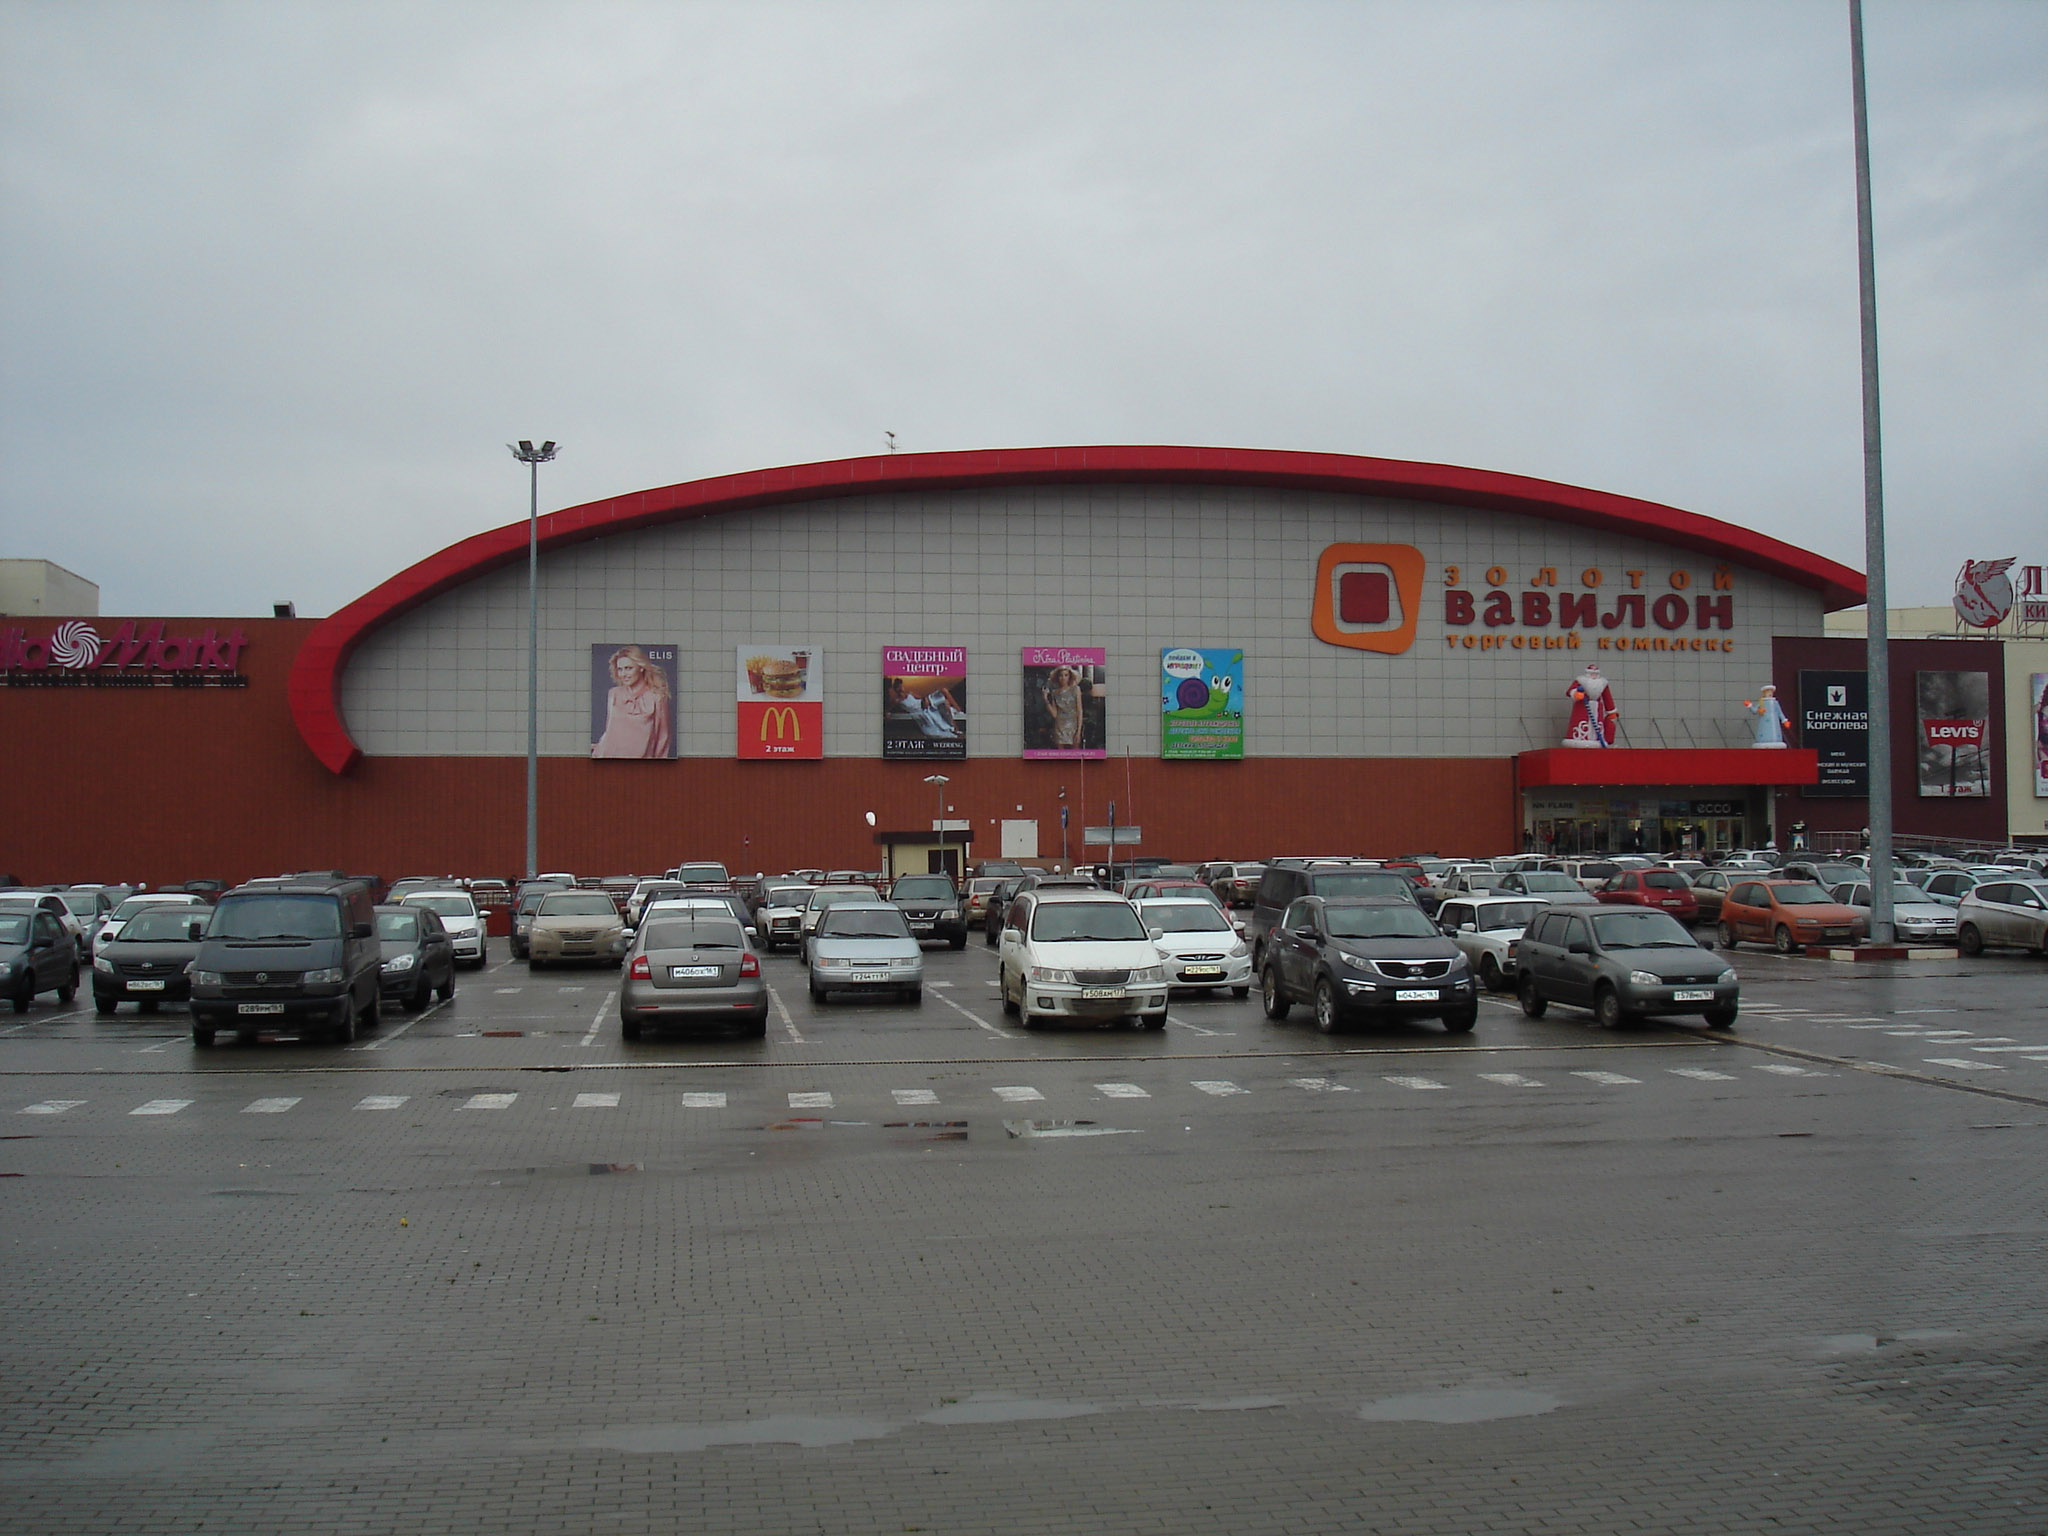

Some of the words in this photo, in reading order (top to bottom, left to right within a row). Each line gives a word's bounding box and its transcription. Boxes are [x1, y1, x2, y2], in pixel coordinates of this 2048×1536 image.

[1444, 563, 1733, 591] золотой
[2021, 566, 2048, 597] Л
[1445, 590, 1734, 629] вавилон
[2025, 605, 2048, 617] КИ
[90, 620, 248, 670] Markt
[1446, 630, 1581, 651] торговый
[1598, 636, 1734, 653] комплекс
[649, 651, 673, 660] ELIS
[886, 649, 963, 663] СВАДЕБНЫЙ
[1806, 711, 1868, 720] Снежная
[1806, 721, 1868, 730] Королева
[887, 740, 893, 749] 2
[895, 740, 925, 749] ЭТАЖ
